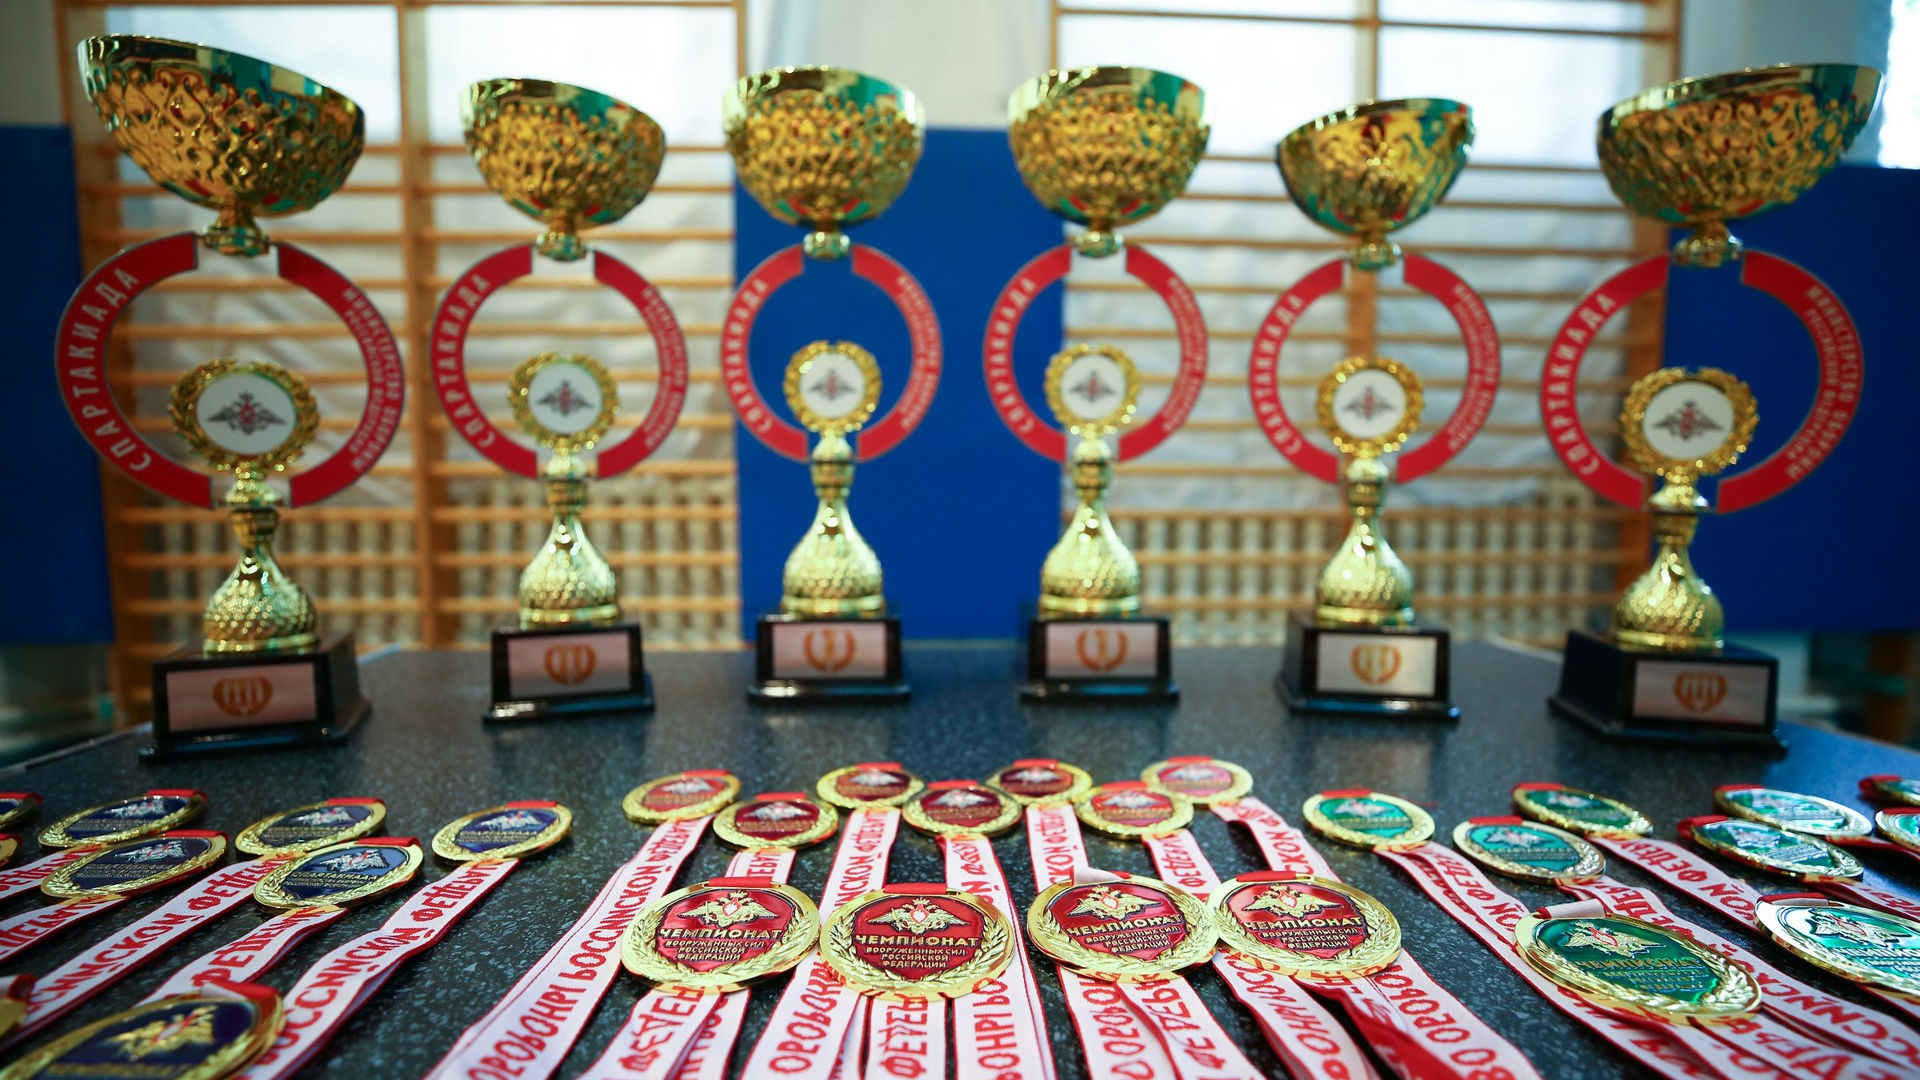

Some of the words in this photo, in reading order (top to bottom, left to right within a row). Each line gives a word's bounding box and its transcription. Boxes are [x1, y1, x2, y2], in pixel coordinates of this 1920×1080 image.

[437, 274, 497, 449] СПАРТАКИАДА
[69, 266, 153, 474] СПАРТАКИАДА
[1254, 293, 1305, 456] СПАРТАКИАДА
[1547, 292, 1618, 475] СПАРТАКИАДА
[1066, 914, 1185, 937] ЧЕМПИОНАТ
[1243, 916, 1363, 931] ЧЕМПИОНАТ
[659, 928, 782, 939] ЧЕМПИОНАТ
[855, 934, 979, 947] ЧЕМПИОНАТ
[1104, 934, 1169, 948] РОССИЙСКОЙ
[1281, 934, 1348, 944] РОССИЙСКОЙ
[880, 953, 949, 961] РОССИЙСКОЙ
